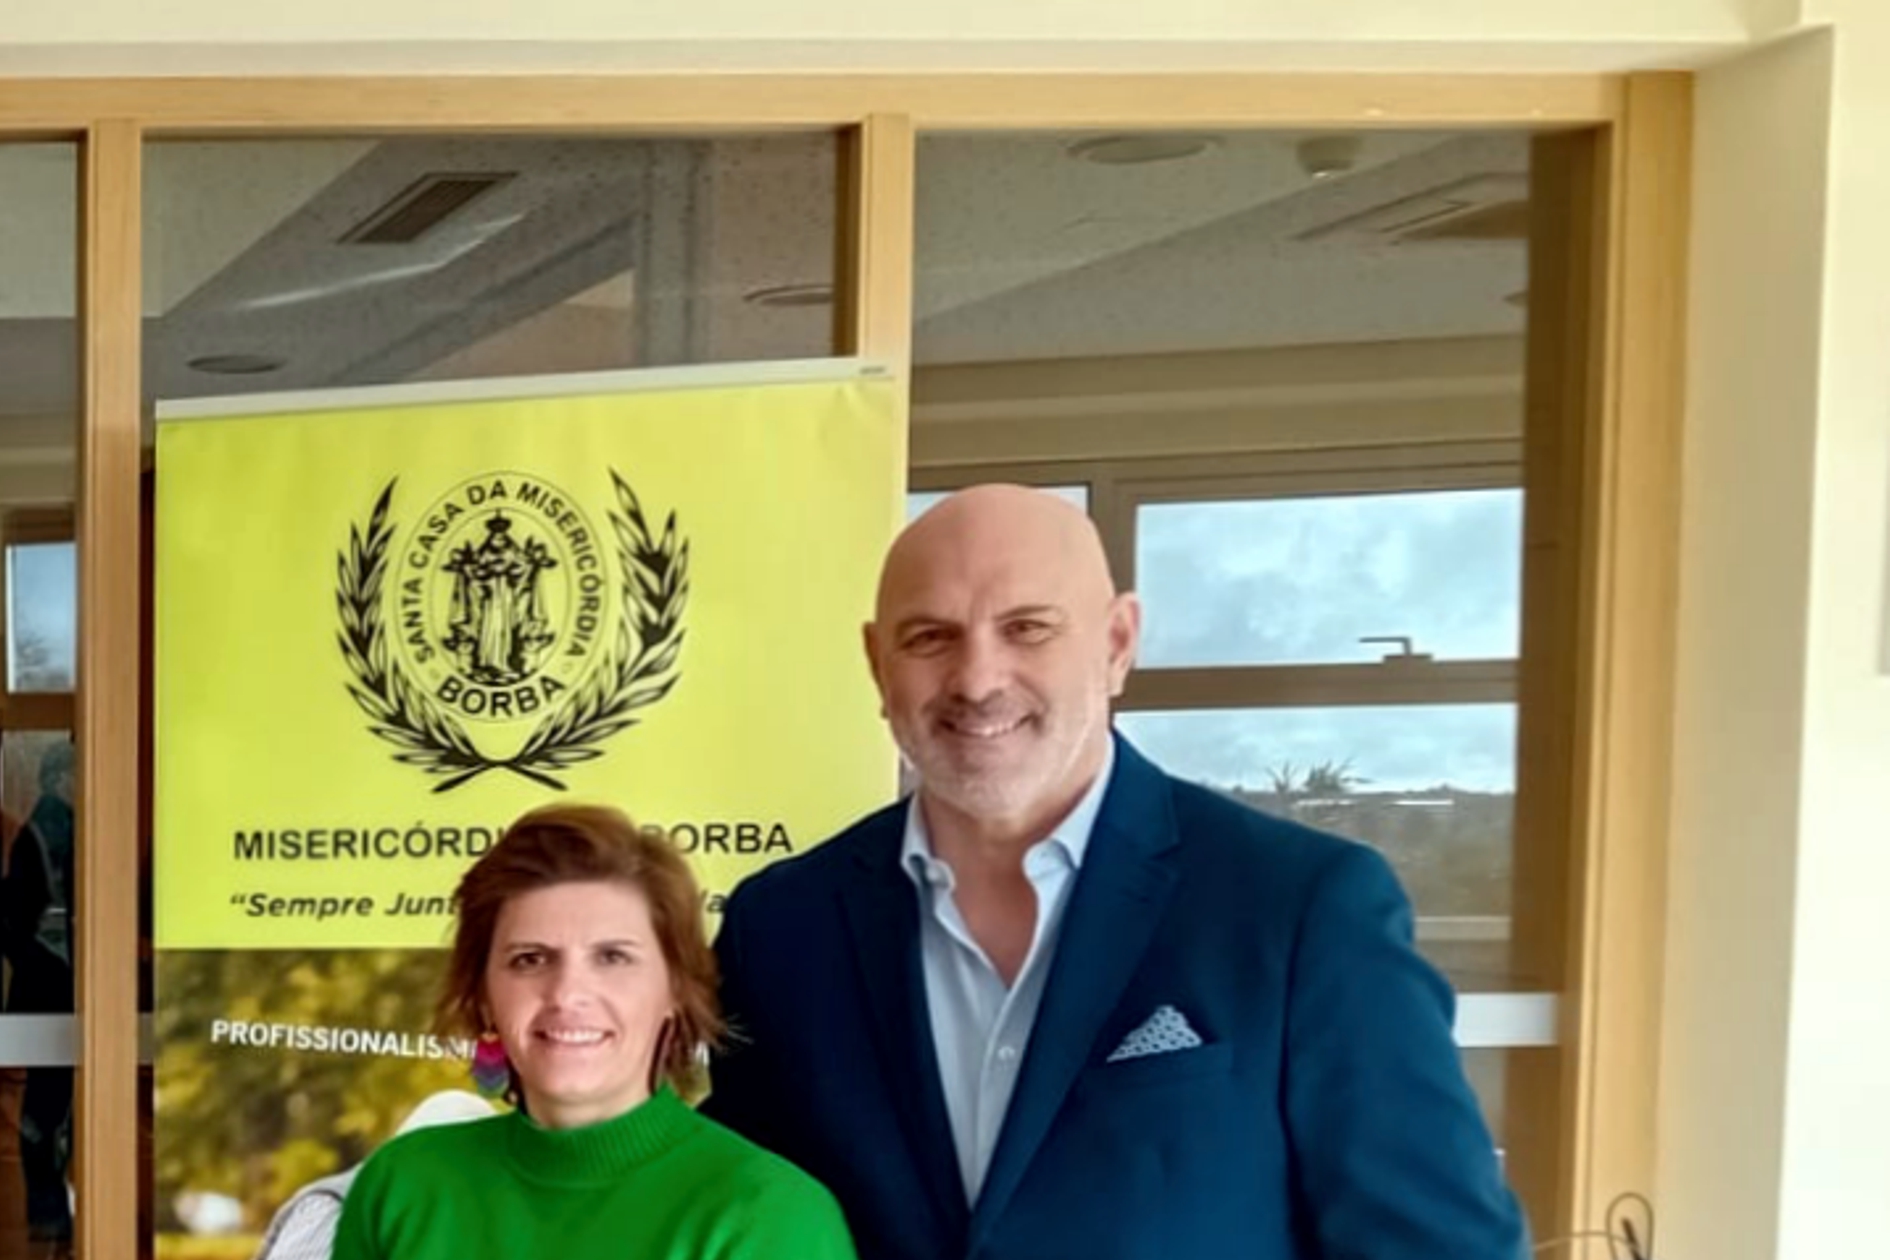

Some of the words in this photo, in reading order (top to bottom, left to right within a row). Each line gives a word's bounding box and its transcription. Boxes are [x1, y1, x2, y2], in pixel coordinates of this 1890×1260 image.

[467, 480, 507, 505] DA
[409, 502, 464, 569] CASA
[516, 482, 605, 656] MISERICÓRDIA
[403, 577, 435, 664] SANTA
[437, 676, 566, 717] BORBA
[234, 821, 504, 860] MISERICÓRD
[384, 892, 457, 917] Junt
[210, 1019, 478, 1061] PROFISSIONALISM
